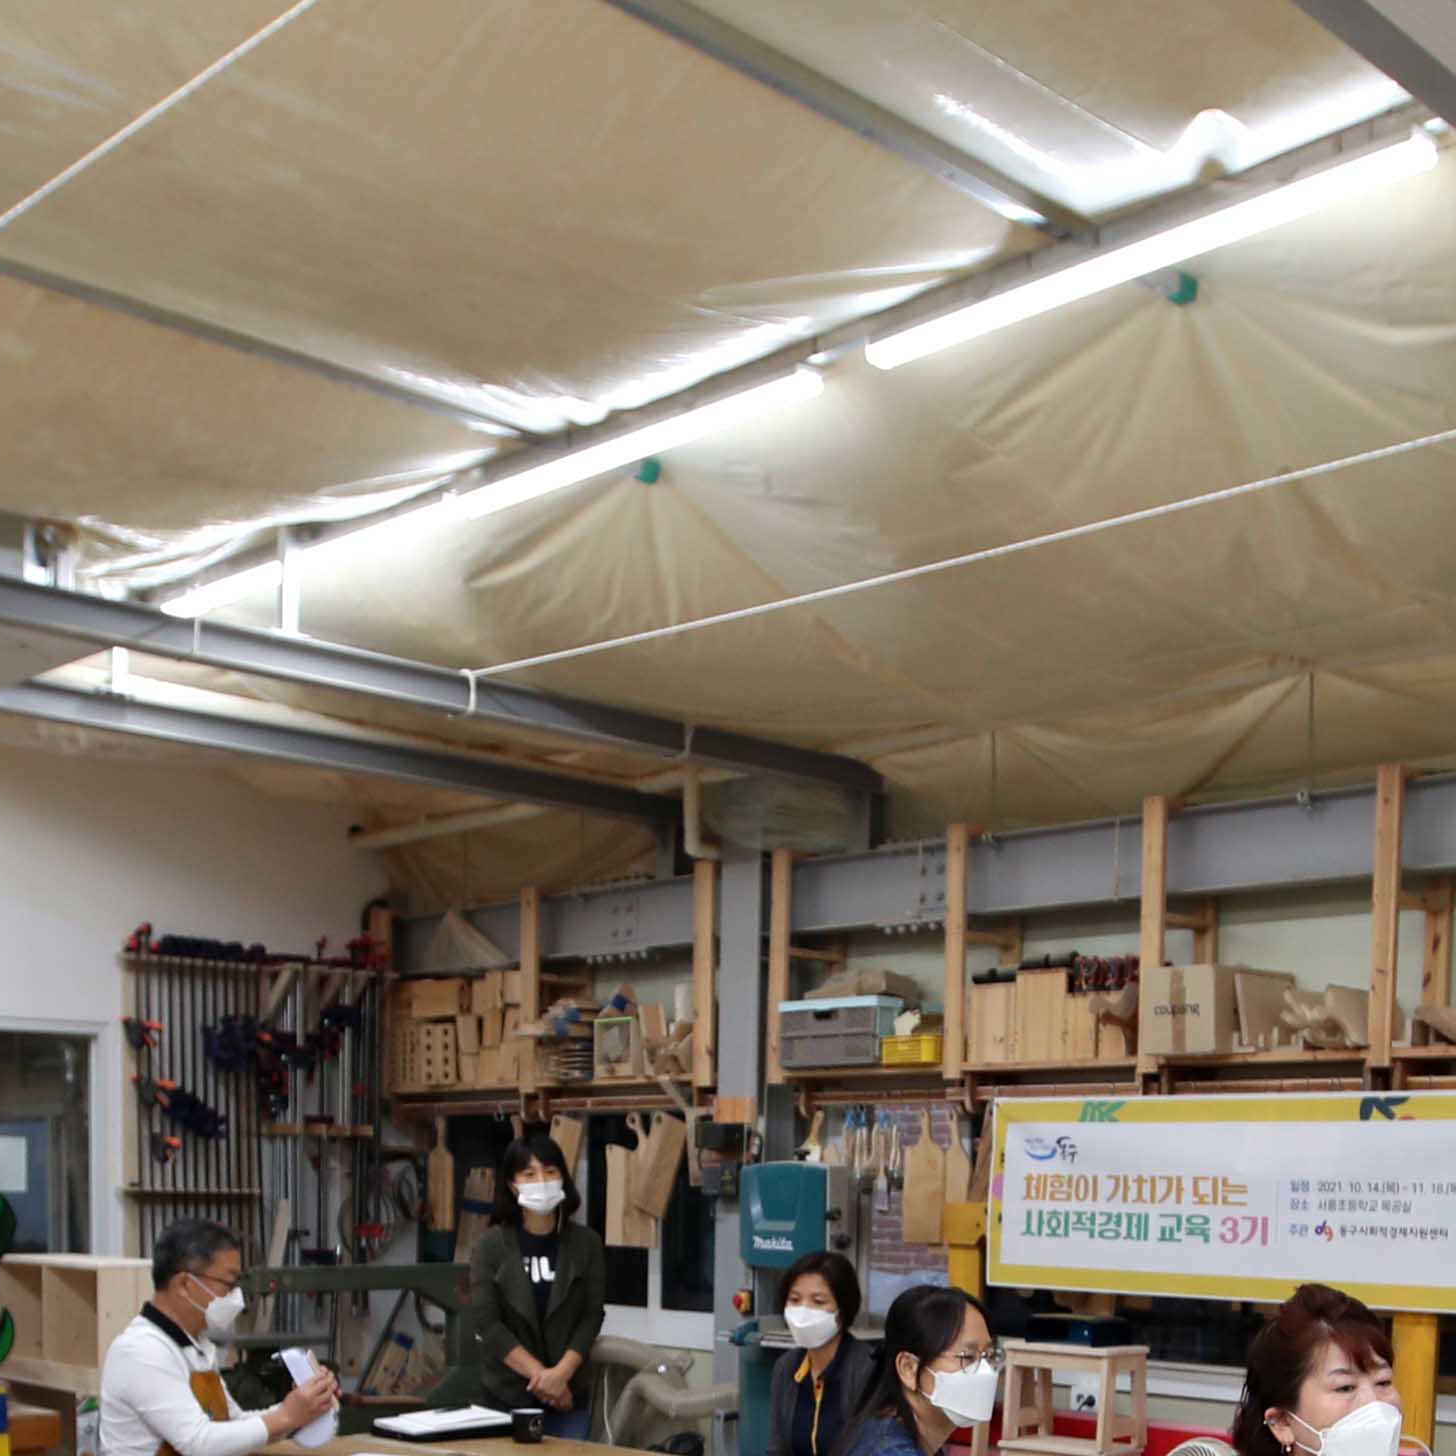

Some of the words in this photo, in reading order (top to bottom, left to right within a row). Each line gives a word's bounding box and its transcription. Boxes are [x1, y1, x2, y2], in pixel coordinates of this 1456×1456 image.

[1023, 1172, 1098, 1202] 체험이
[1106, 1174, 1184, 1204] 가치가
[1192, 1176, 1248, 1207] 되는
[1021, 1208, 1149, 1241] 사회적경제
[1156, 1213, 1211, 1243] 교육
[1218, 1215, 1269, 1247] 3기
